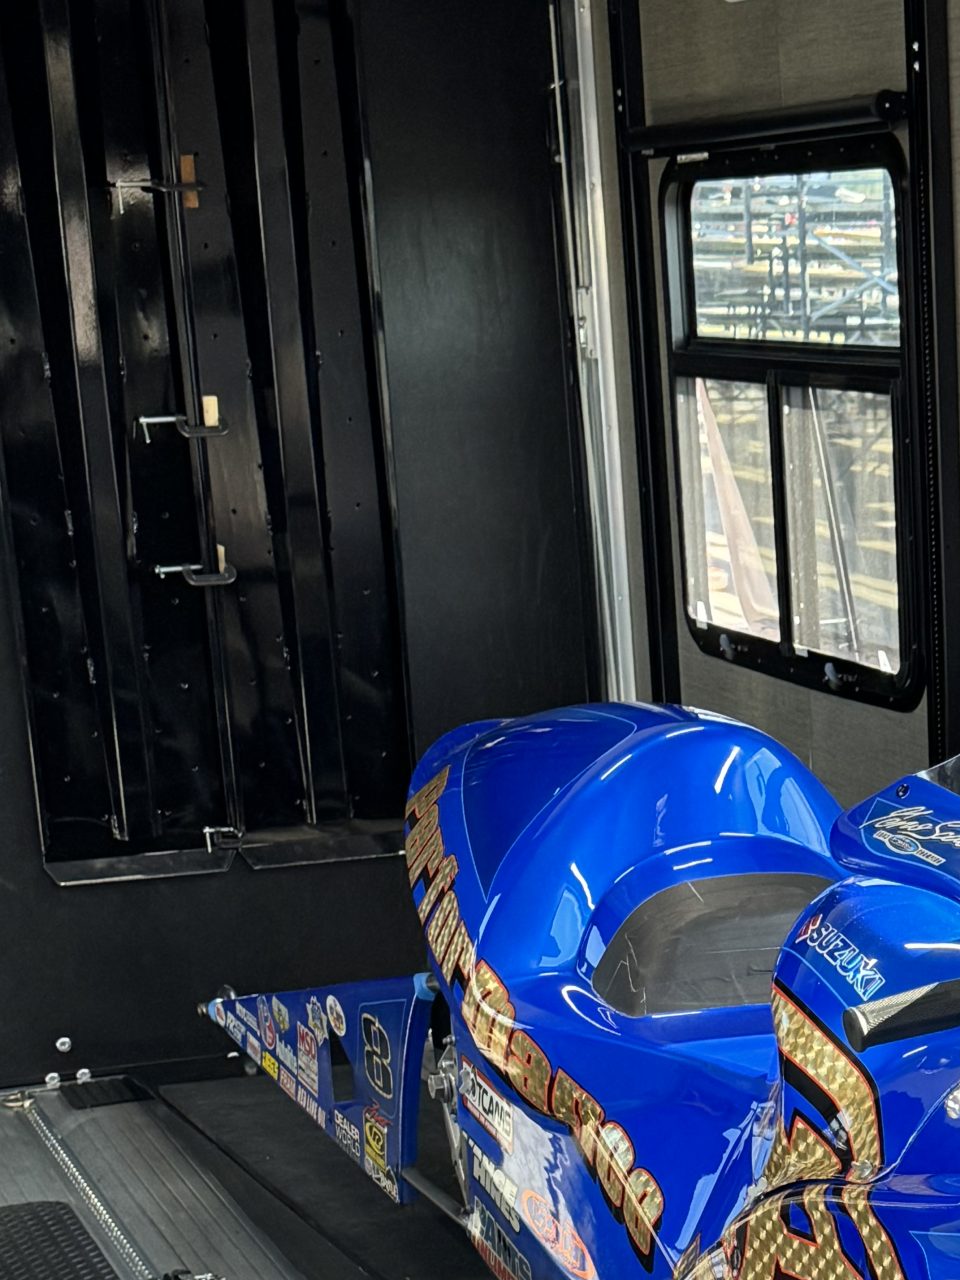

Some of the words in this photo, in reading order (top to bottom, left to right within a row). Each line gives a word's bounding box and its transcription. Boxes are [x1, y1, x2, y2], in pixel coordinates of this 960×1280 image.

[807, 922, 886, 1001] SUZUKI
[361, 1012, 394, 1100] 8
[333, 1109, 361, 1143] DEALER
[334, 1125, 361, 1157] WORLD
[473, 1160, 521, 1233] HINES
